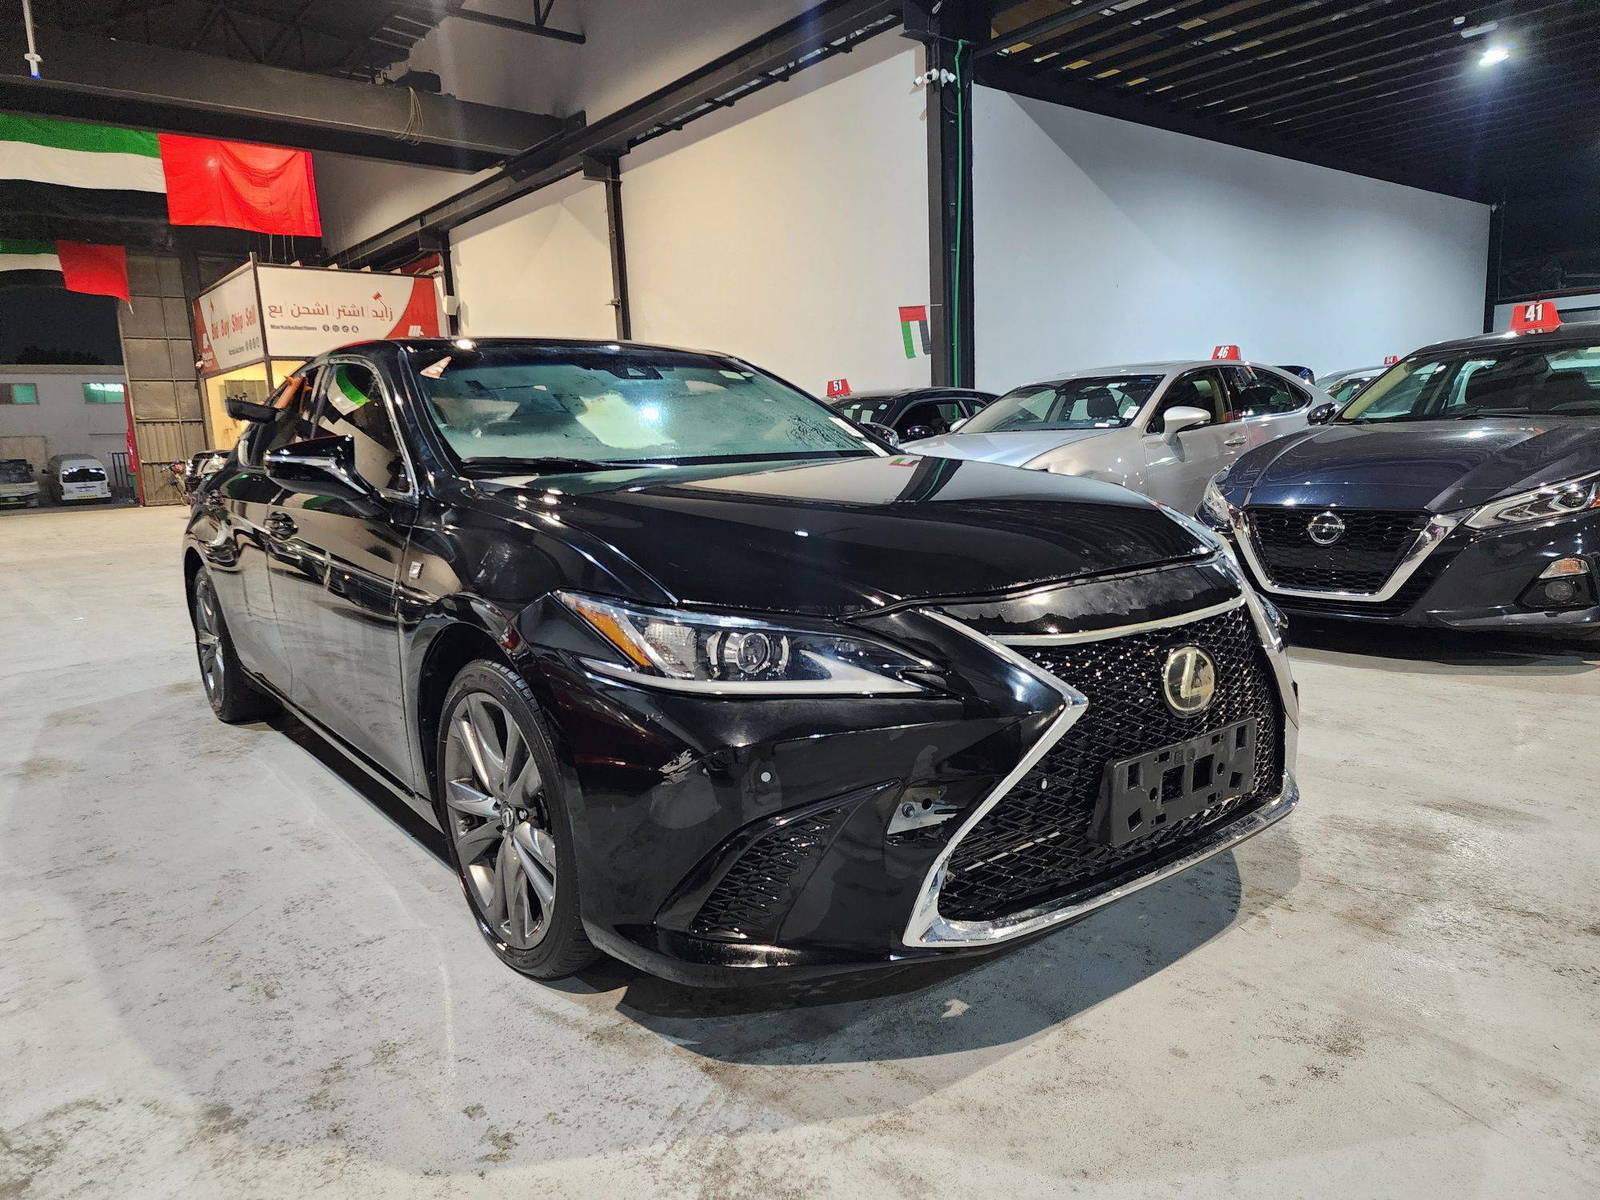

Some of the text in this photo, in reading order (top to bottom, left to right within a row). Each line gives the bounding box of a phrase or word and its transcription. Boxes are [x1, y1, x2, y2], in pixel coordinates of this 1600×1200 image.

[267, 304, 284, 318] بع
[290, 302, 329, 318] اشحن
[336, 303, 365, 320] اشتر
[1525, 304, 1543, 322] 41
[1217, 346, 1230, 359] 46
[833, 380, 843, 391] 51
